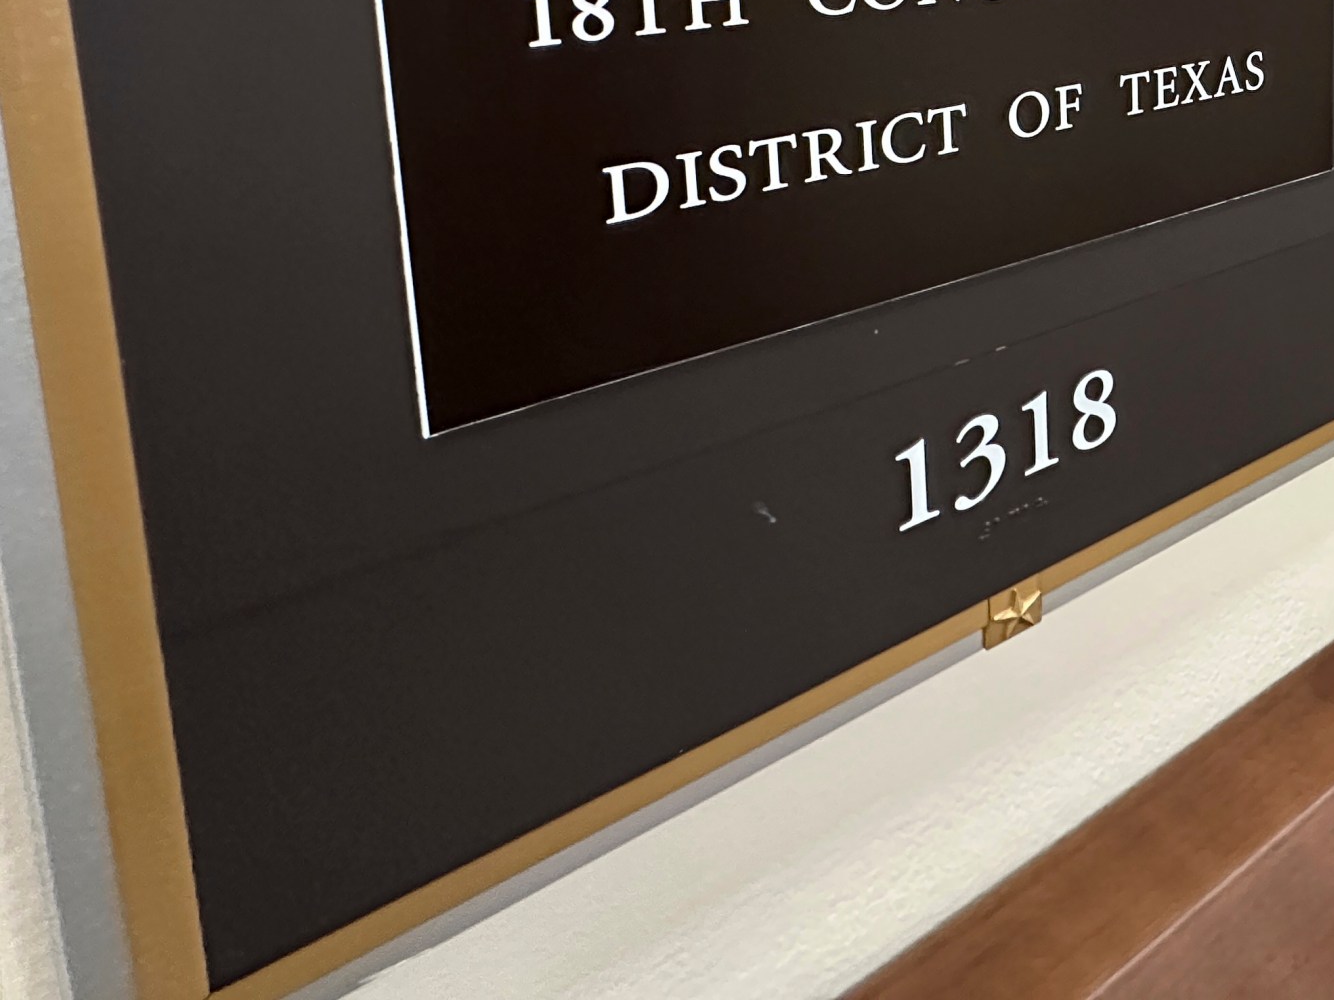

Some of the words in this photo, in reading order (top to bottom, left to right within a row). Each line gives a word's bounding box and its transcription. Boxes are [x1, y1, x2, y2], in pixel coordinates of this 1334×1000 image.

[602, 103, 967, 225] DISTRICT
[1008, 83, 1083, 138] OF
[1119, 50, 1266, 116] TEXAS
[895, 369, 1117, 532] 1318
